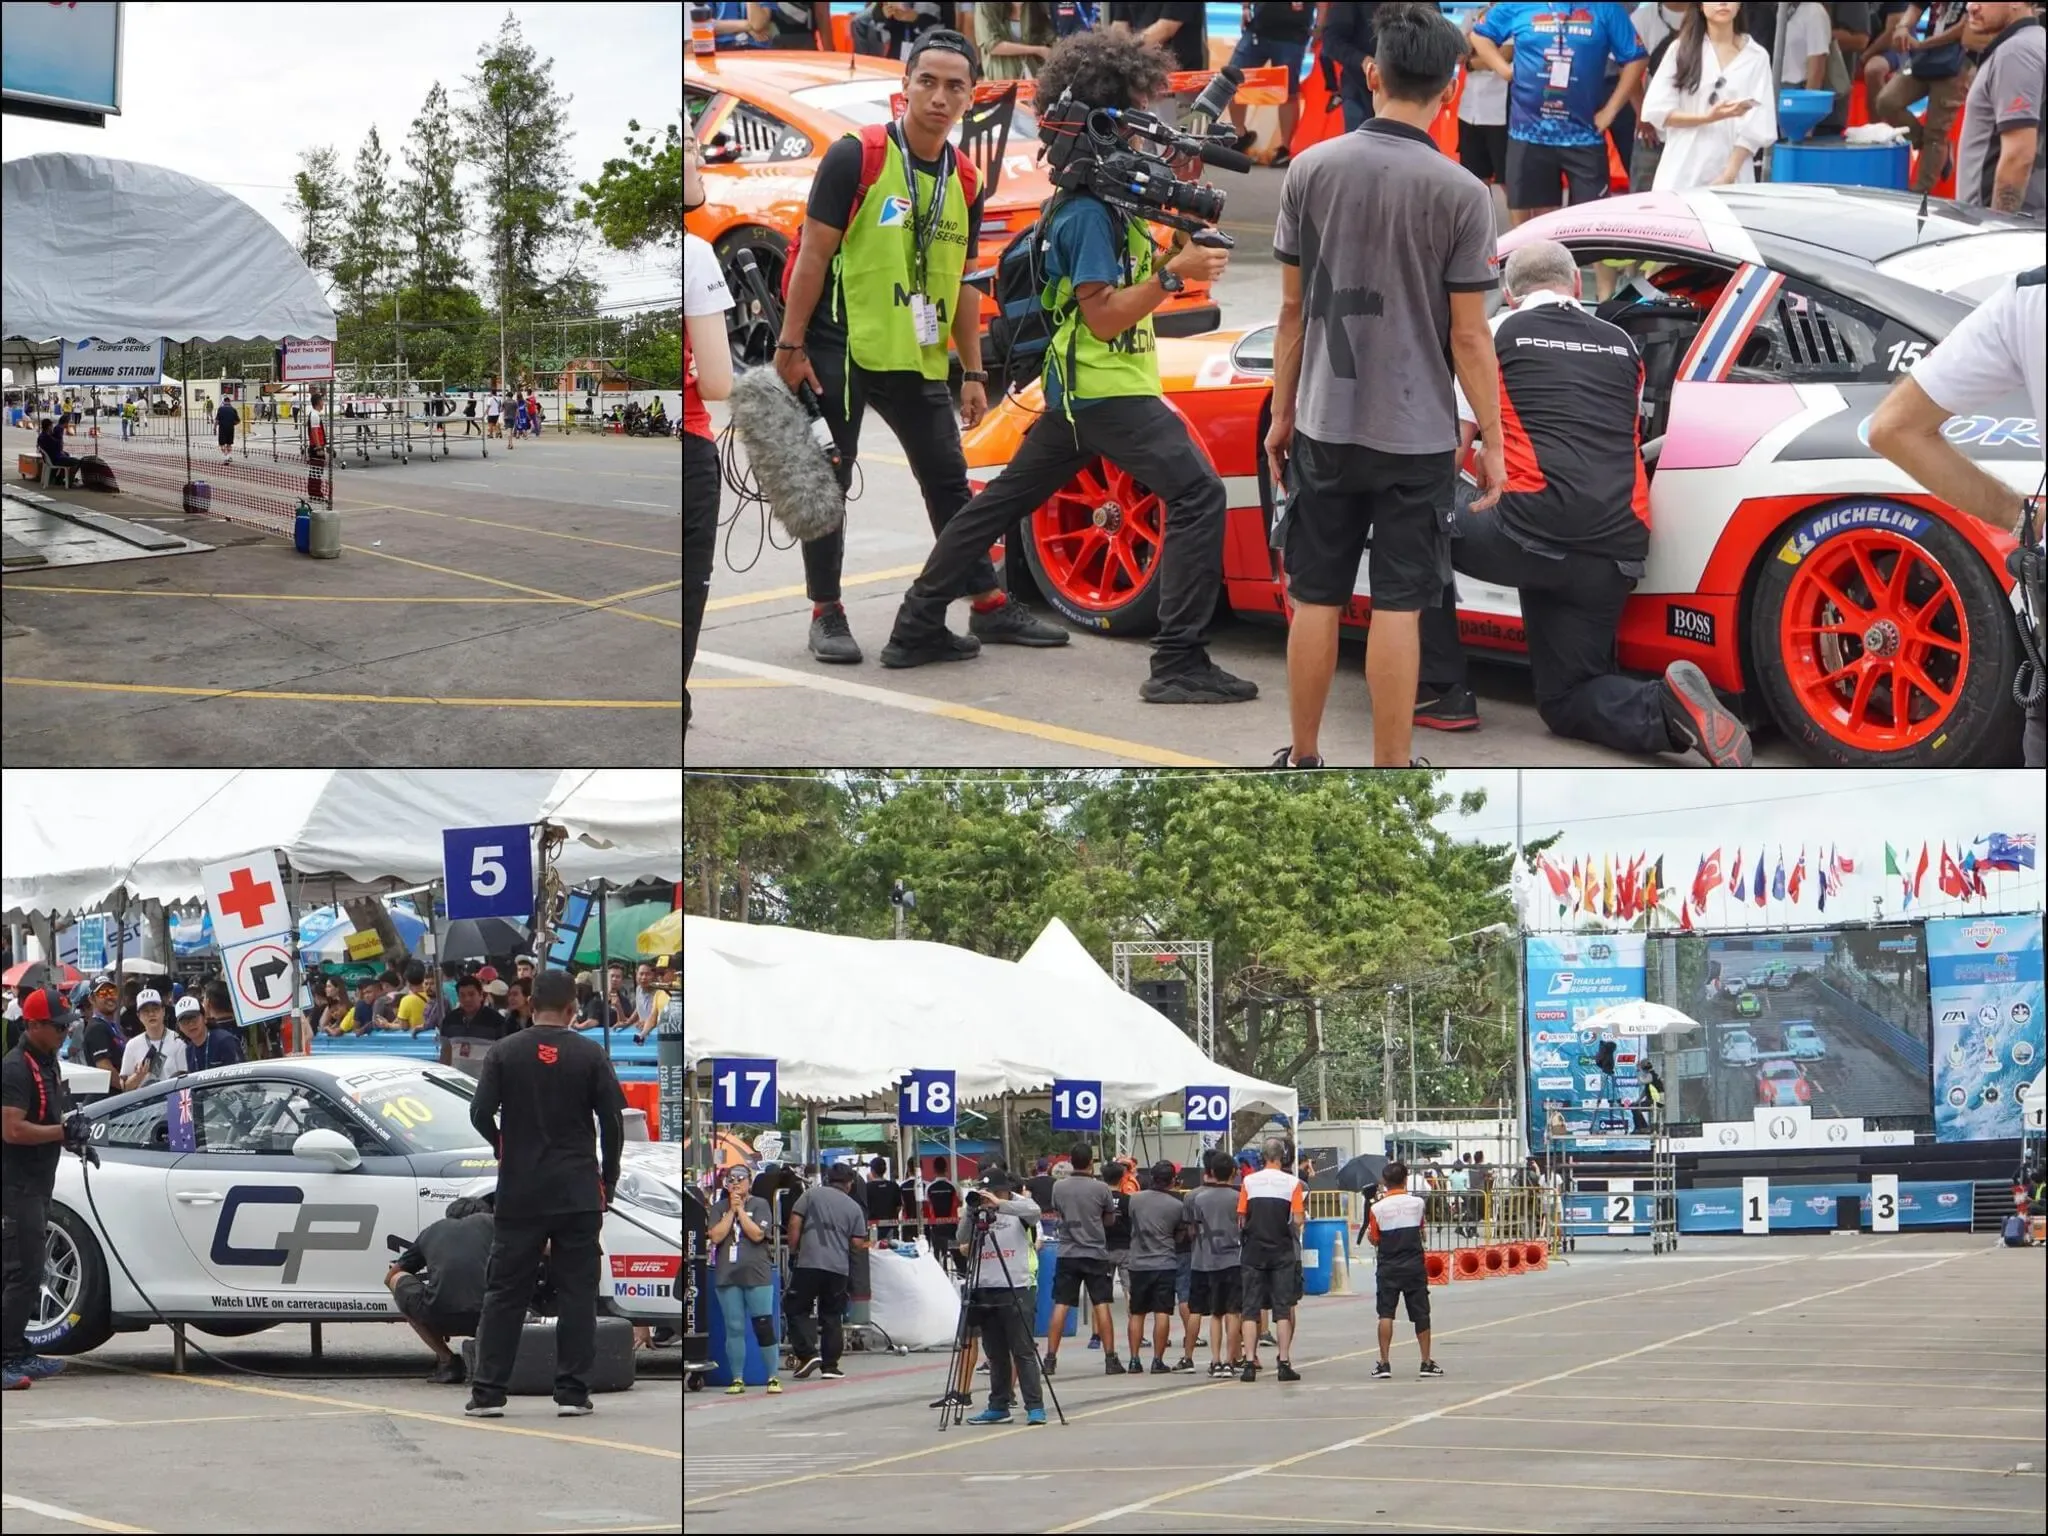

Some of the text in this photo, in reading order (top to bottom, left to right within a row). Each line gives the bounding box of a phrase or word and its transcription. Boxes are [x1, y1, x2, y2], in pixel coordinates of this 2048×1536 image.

[783, 136, 806, 158] 99
[935, 230, 968, 246] SERIES
[1516, 337, 1629, 357] PORSCHE
[1887, 340, 1928, 373] 15
[68, 366, 155, 377] WEIGHING STATION
[1812, 506, 1919, 538] MICHELIN
[1675, 608, 1711, 635] BOSS
[470, 845, 507, 897] 5
[1570, 984, 1628, 993] SUPER SERIES
[1573, 977, 1612, 985] THAILAND
[718, 1071, 772, 1108] 17
[903, 1081, 952, 1114] 18
[341, 1095, 391, 1141] www.porsche.com
[382, 1096, 433, 1129] 10
[1055, 1089, 1098, 1121] 19
[1187, 1094, 1228, 1121] 20
[1613, 1196, 1630, 1221] 2
[1749, 1196, 1762, 1221] 1
[1878, 1194, 1895, 1219] 3
[210, 1185, 379, 1285] CP
[615, 1282, 655, 1297] Mobil
[212, 1295, 388, 1312] Watch LIVE on carreracupasia.com
